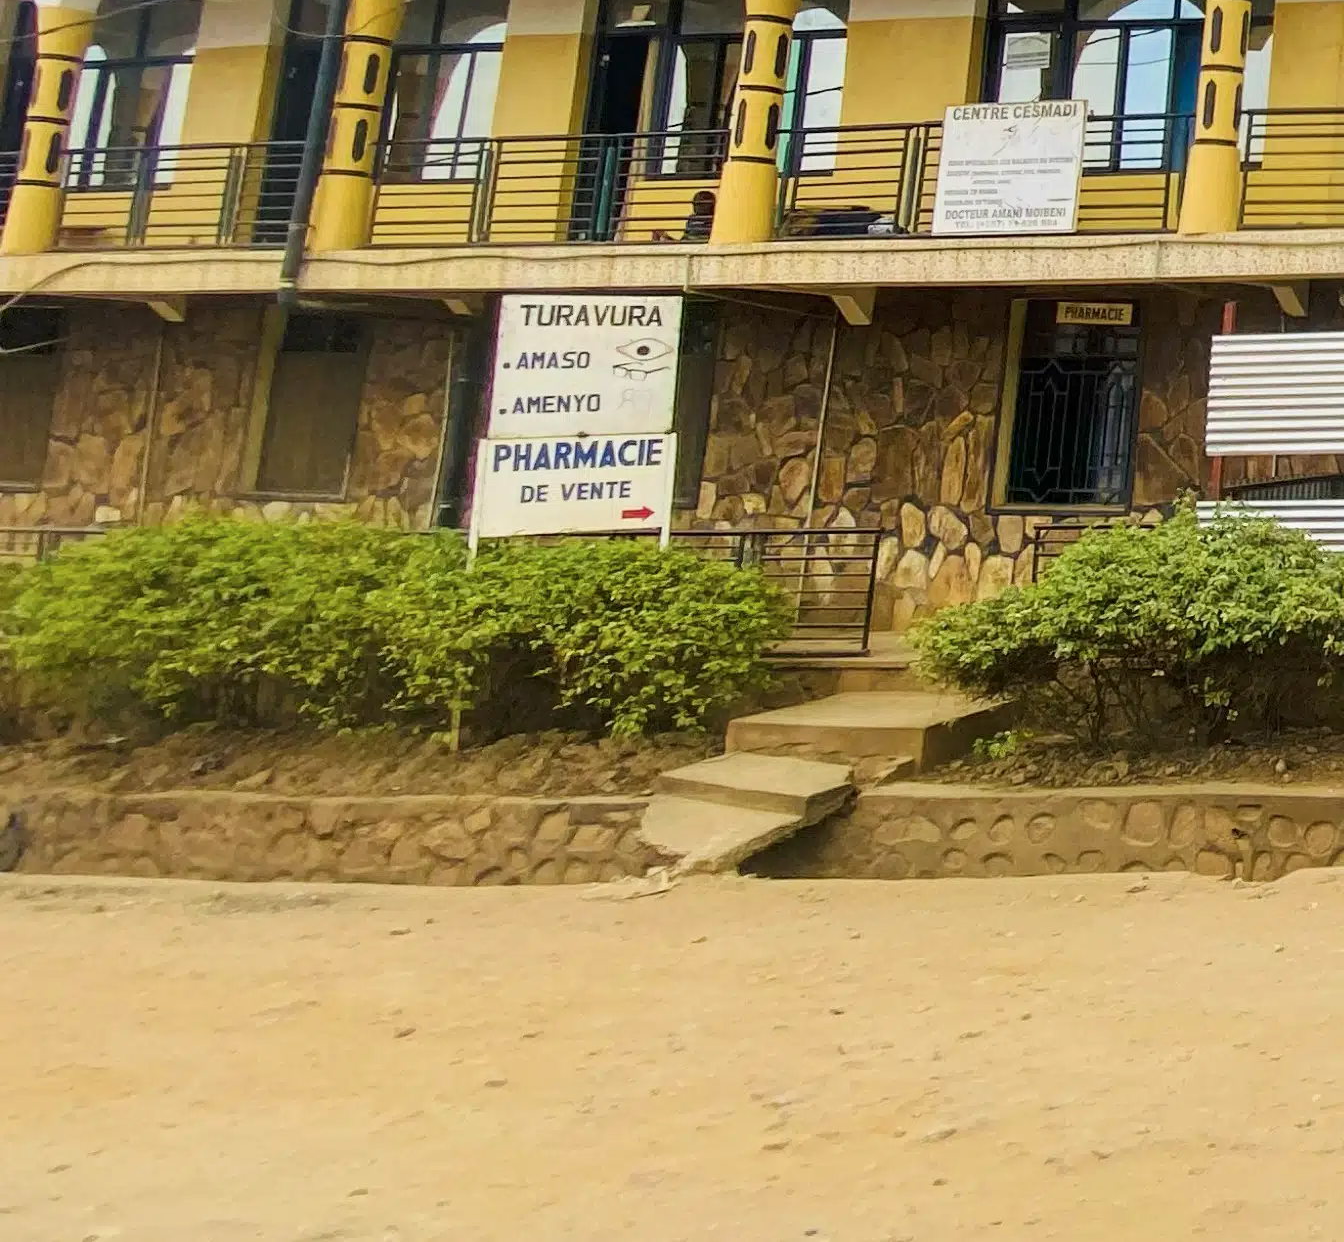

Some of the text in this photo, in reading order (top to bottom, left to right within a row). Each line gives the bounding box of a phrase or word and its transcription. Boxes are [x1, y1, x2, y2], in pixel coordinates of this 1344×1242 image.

[953, 103, 1077, 121] CENTRE CESMADI
[945, 209, 989, 220] DOCTEUR
[991, 207, 1023, 219] AMANI
[521, 304, 662, 327] TURAVURA
[1064, 306, 1124, 320] PHARMACIE
[516, 351, 590, 370] AMASO
[512, 393, 601, 414] AMENYO
[493, 438, 663, 473] PHARMACIE
[520, 480, 631, 504] DE VENTE
